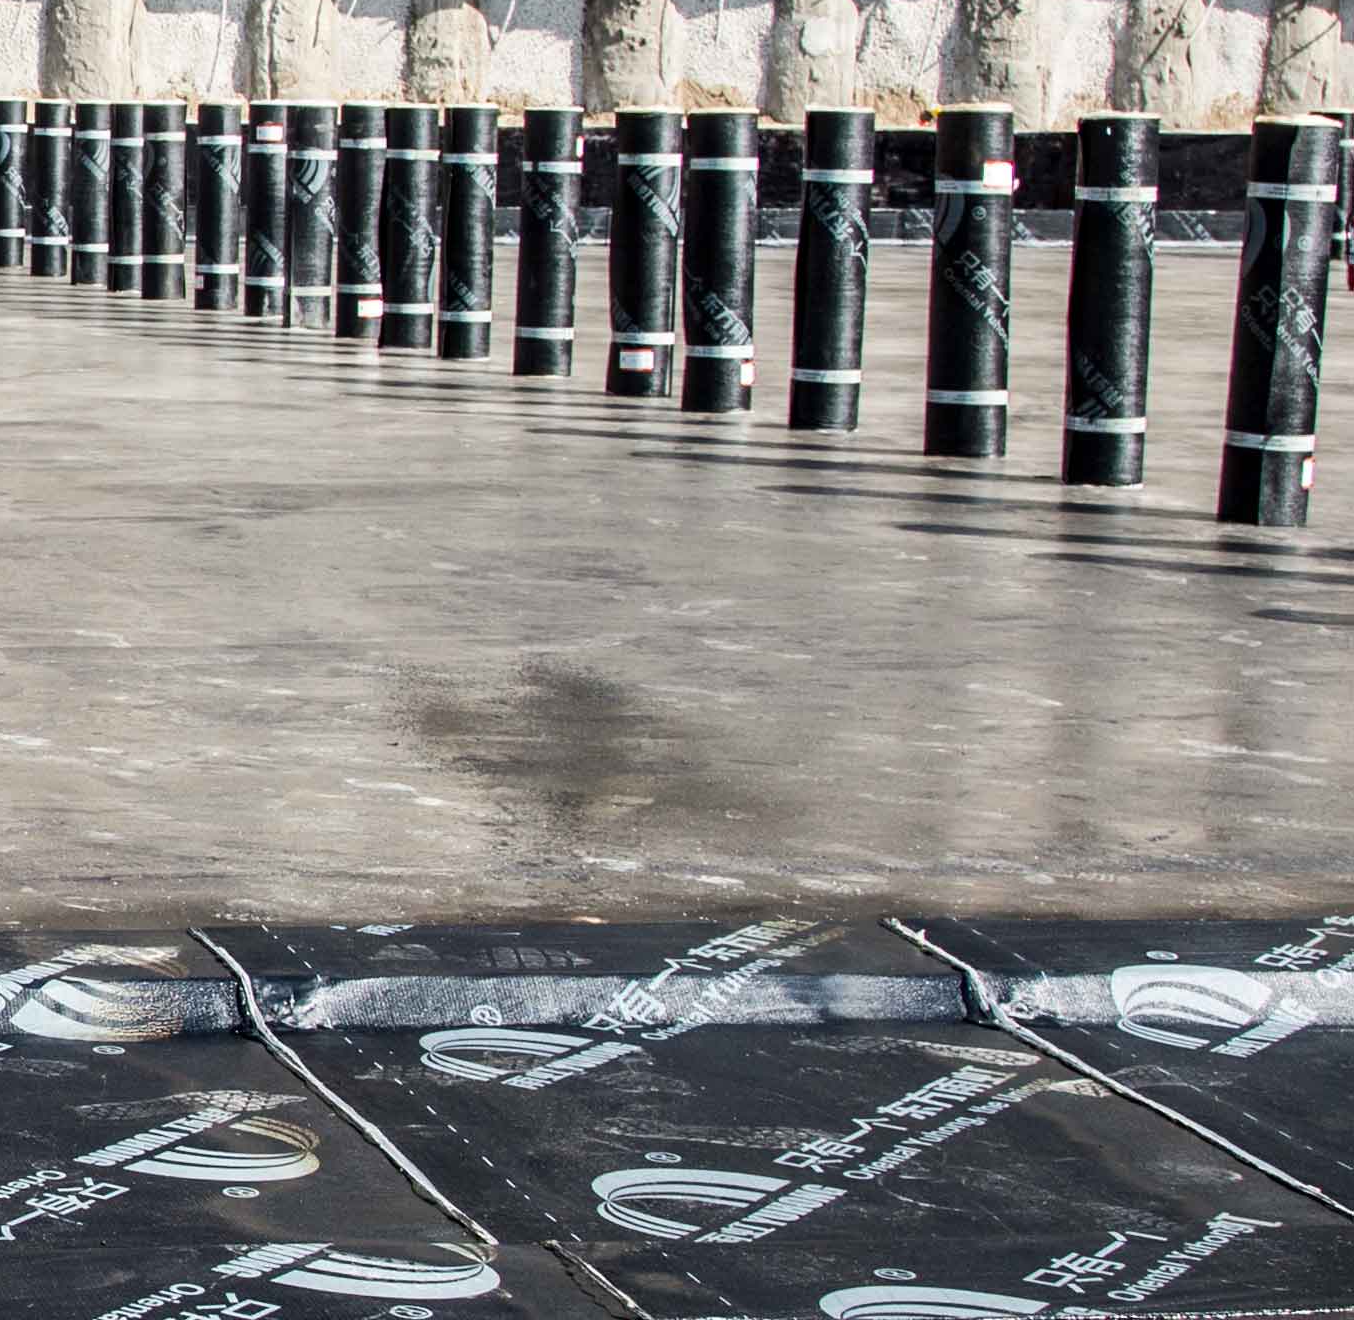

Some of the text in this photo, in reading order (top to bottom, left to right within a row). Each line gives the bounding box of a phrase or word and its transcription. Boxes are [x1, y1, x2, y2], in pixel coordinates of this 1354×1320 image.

[500, 1040, 643, 1091] 雨虹 YUHONG
[72, 1128, 191, 1167] YUHONG
[842, 1142, 923, 1181] Oriental
[741, 1183, 849, 1227] YUHONG
[1106, 1259, 1193, 1302] Oriental
